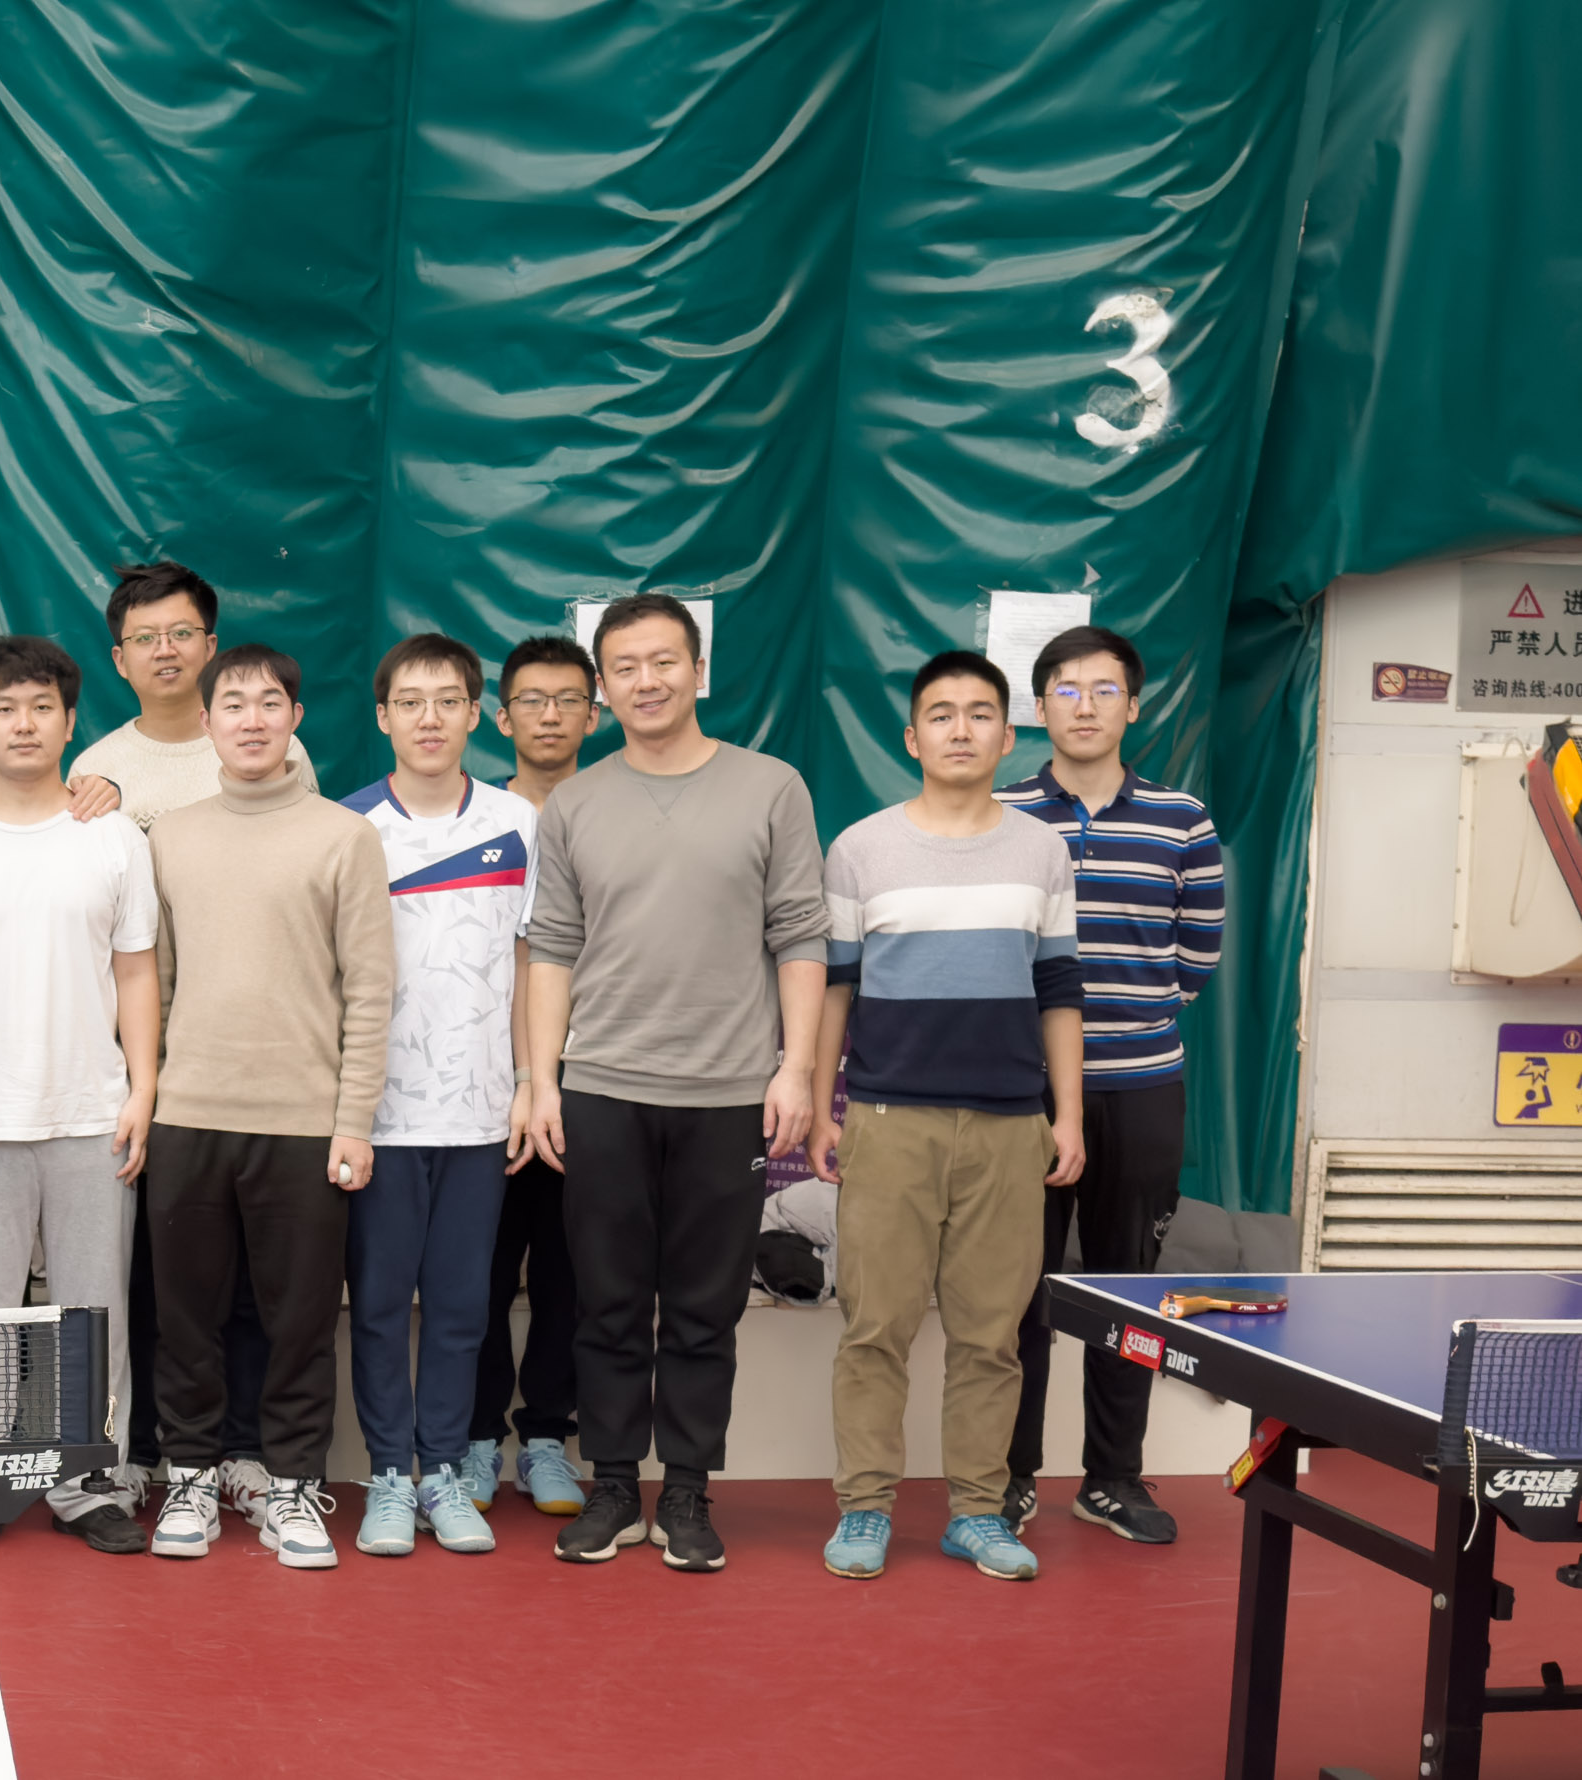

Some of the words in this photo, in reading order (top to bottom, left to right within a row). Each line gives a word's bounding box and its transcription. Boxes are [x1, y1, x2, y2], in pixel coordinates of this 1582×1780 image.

[1074, 293, 1171, 448] 3
[1166, 1347, 1199, 1376] DHS
[9, 1474, 60, 1490] DHS
[1485, 1469, 1579, 1498] 红双喜
[1523, 1492, 1572, 1507] DHS
